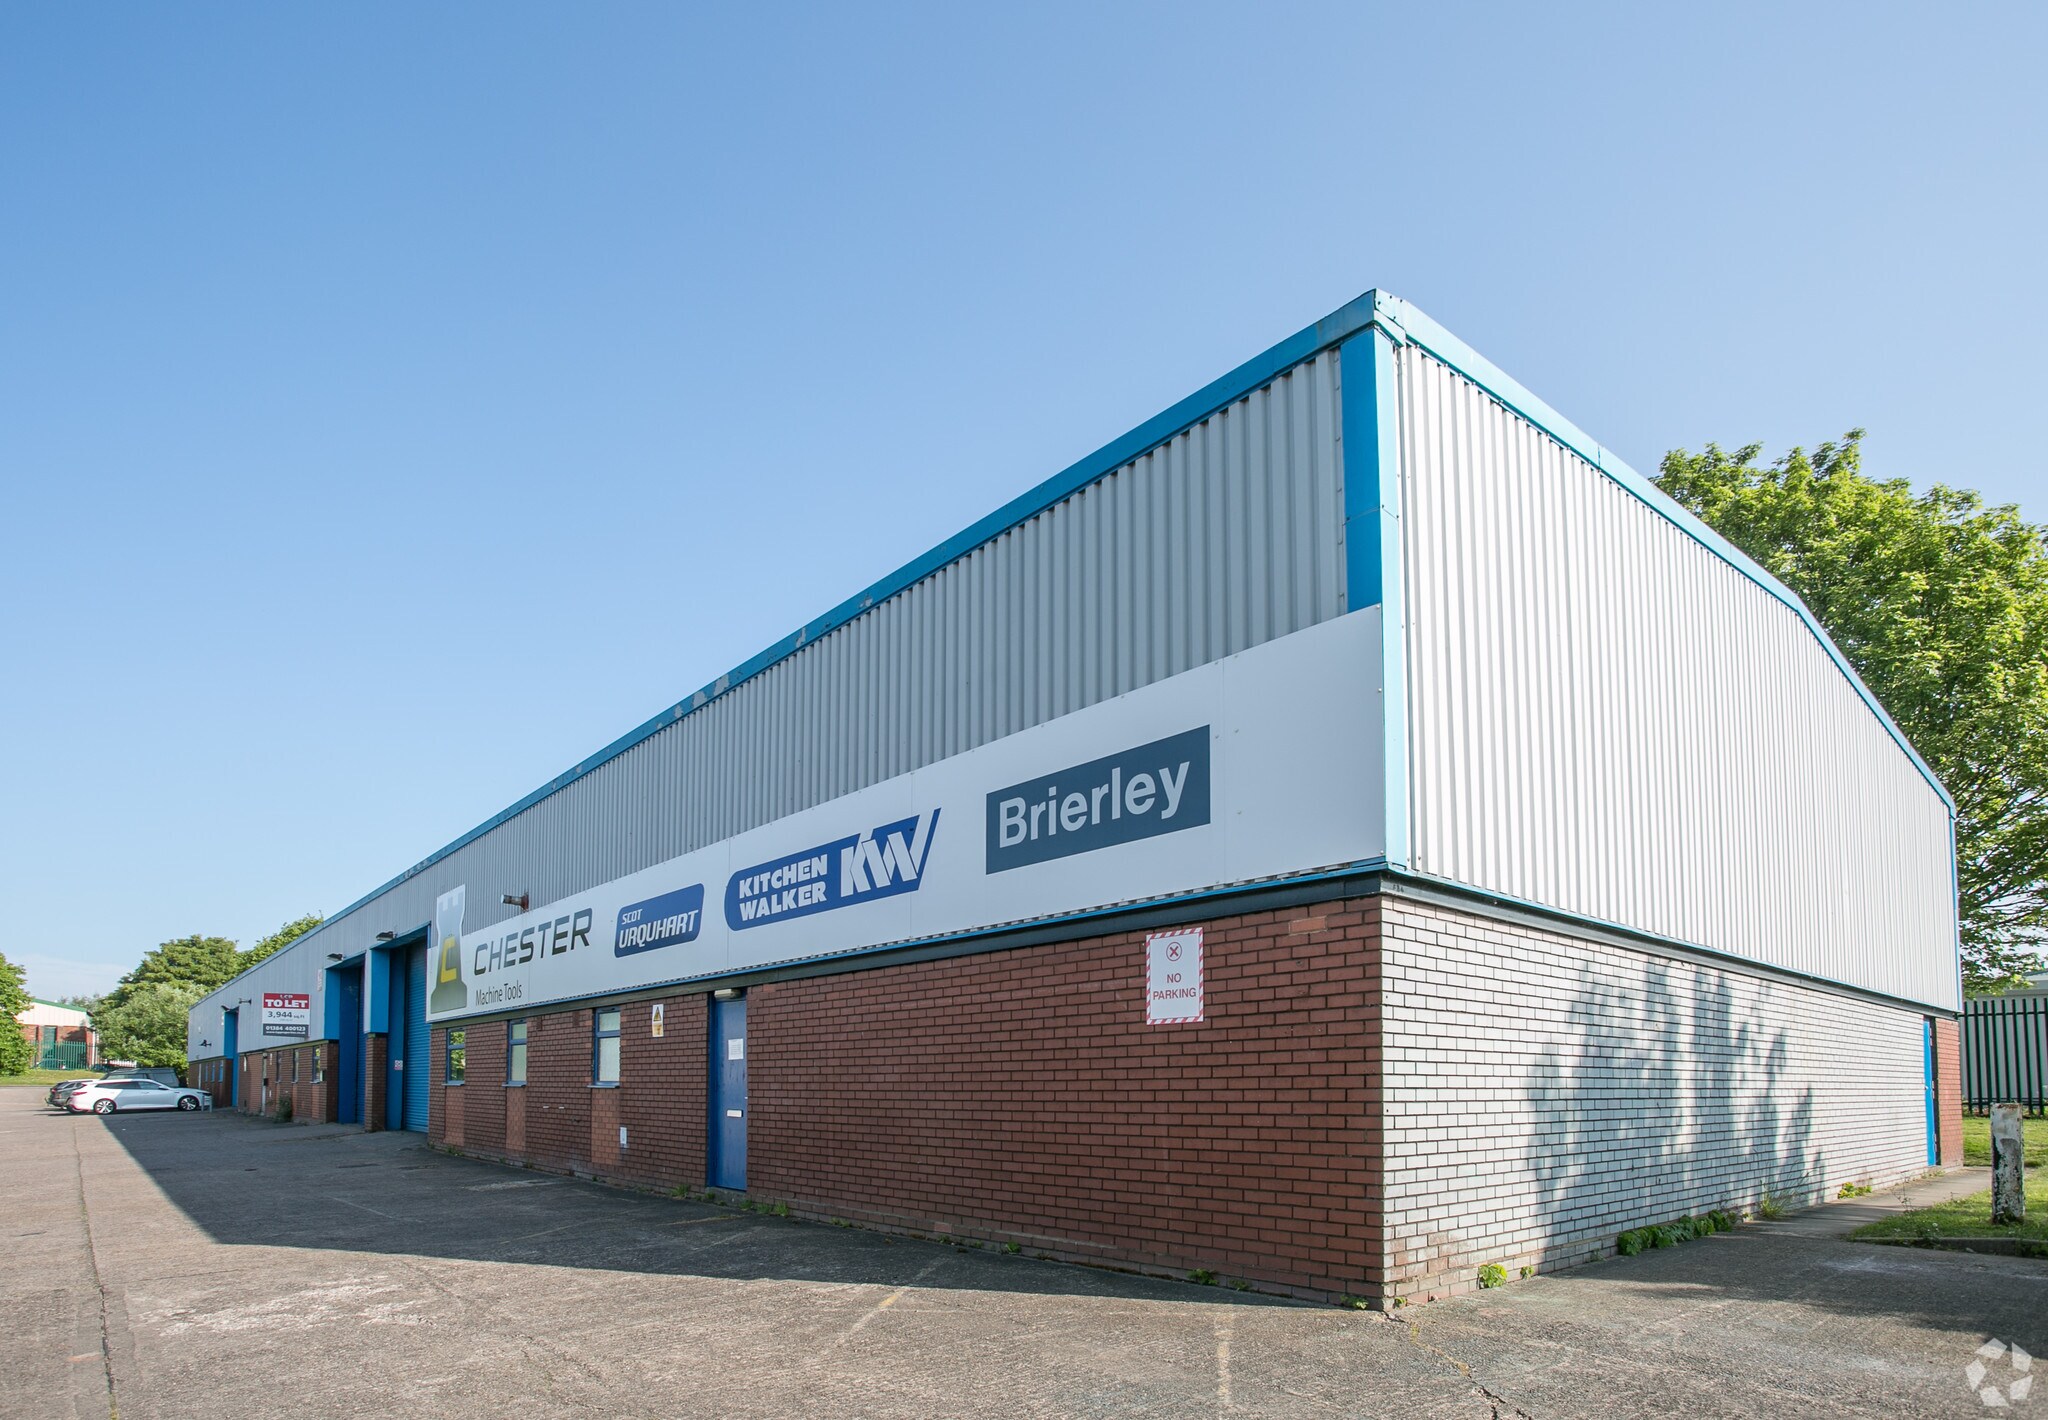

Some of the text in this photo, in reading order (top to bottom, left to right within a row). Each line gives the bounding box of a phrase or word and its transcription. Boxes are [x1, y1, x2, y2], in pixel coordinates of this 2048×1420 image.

[1000, 761, 1190, 848] Brierley
[840, 813, 937, 898] KW
[739, 853, 828, 899] KITCHEN
[621, 908, 643, 925] SCOT
[739, 881, 827, 922] WALKER
[474, 907, 593, 976] CHESTER
[618, 909, 699, 949] URQUHART
[475, 979, 523, 1006] Machine Tools
[1152, 987, 1197, 1001] PARKING
[1166, 972, 1182, 984] NO
[265, 999, 308, 1008] TO LET
